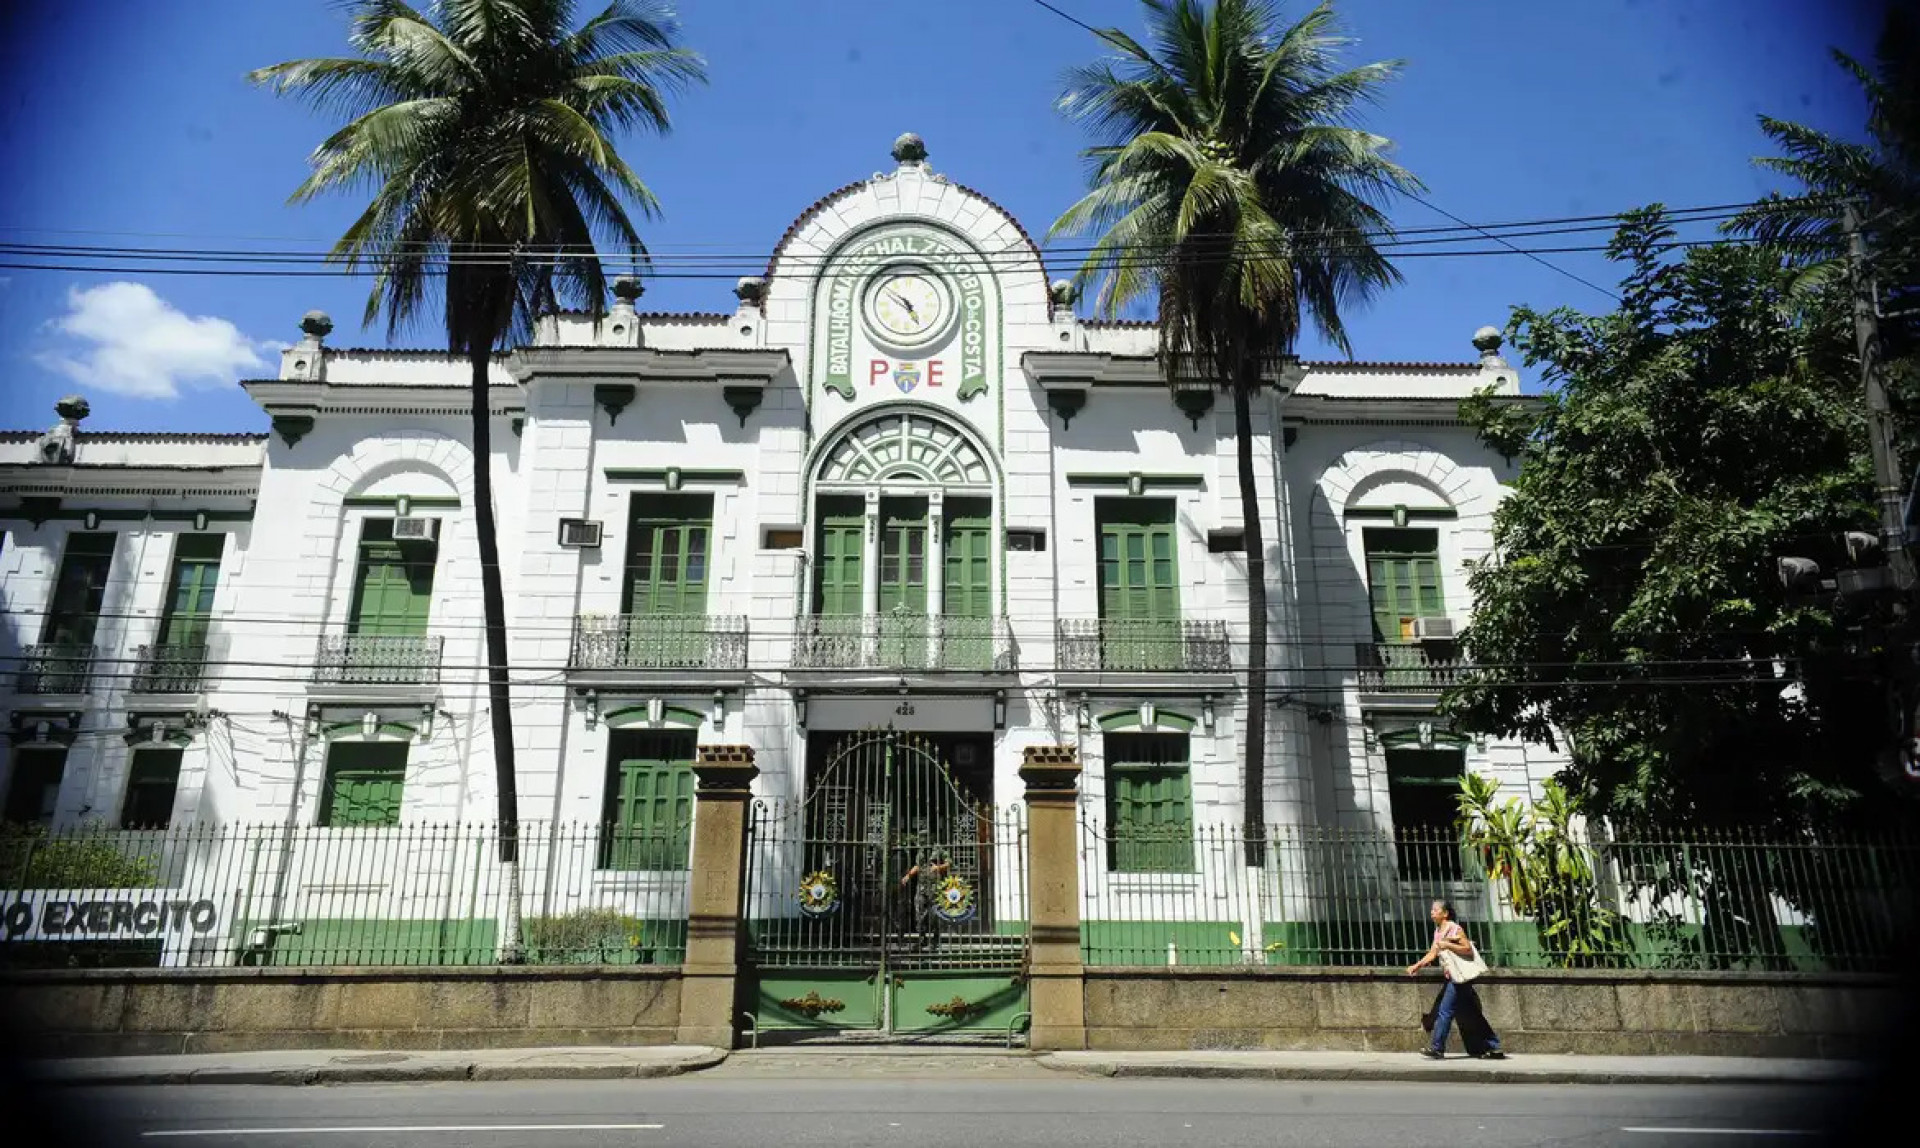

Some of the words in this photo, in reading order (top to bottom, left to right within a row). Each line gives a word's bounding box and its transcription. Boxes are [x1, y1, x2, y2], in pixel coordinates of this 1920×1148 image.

[965, 319, 982, 379] COSTA
[870, 360, 889, 386] P
[927, 360, 943, 387] E
[0, 901, 33, 936] O
[41, 899, 217, 934] EXERCITO
